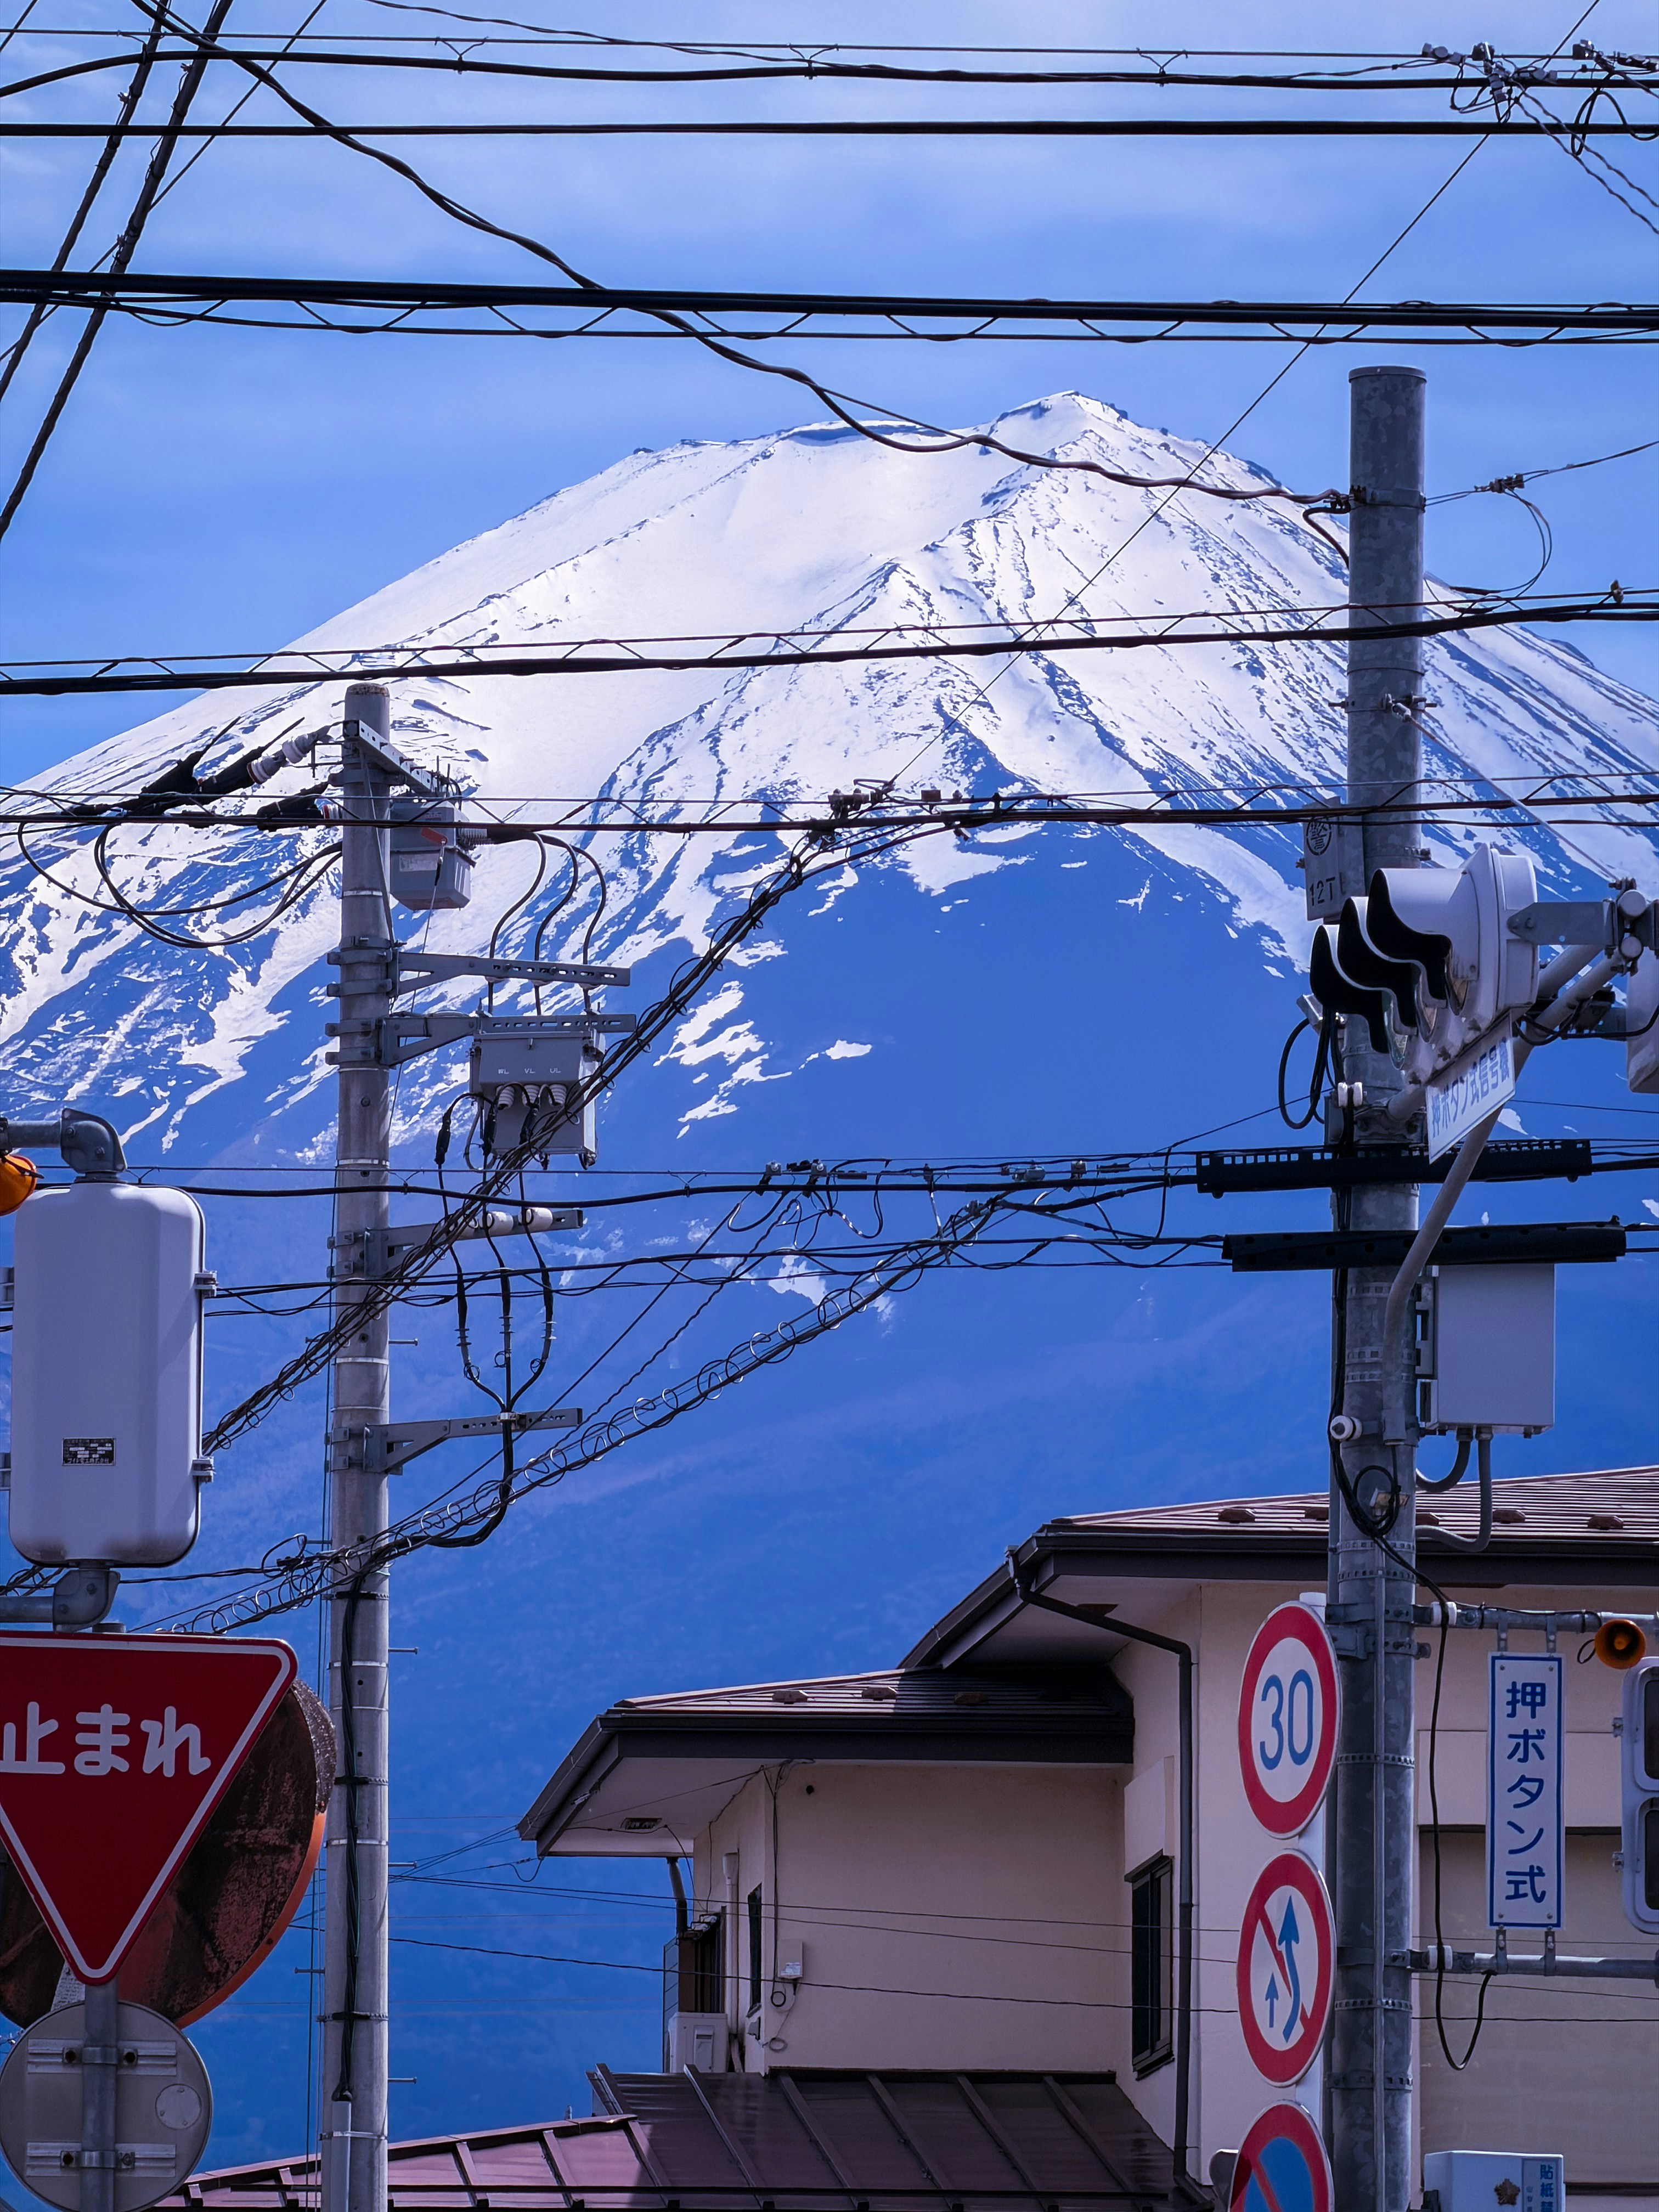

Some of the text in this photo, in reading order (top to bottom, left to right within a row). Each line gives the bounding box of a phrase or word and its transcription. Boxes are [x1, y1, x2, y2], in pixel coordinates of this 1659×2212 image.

[0, 1701, 211, 1778] 止まれ
[1260, 1669, 1313, 1771] 30
[1505, 1681, 1547, 1904] 押ボタン式
